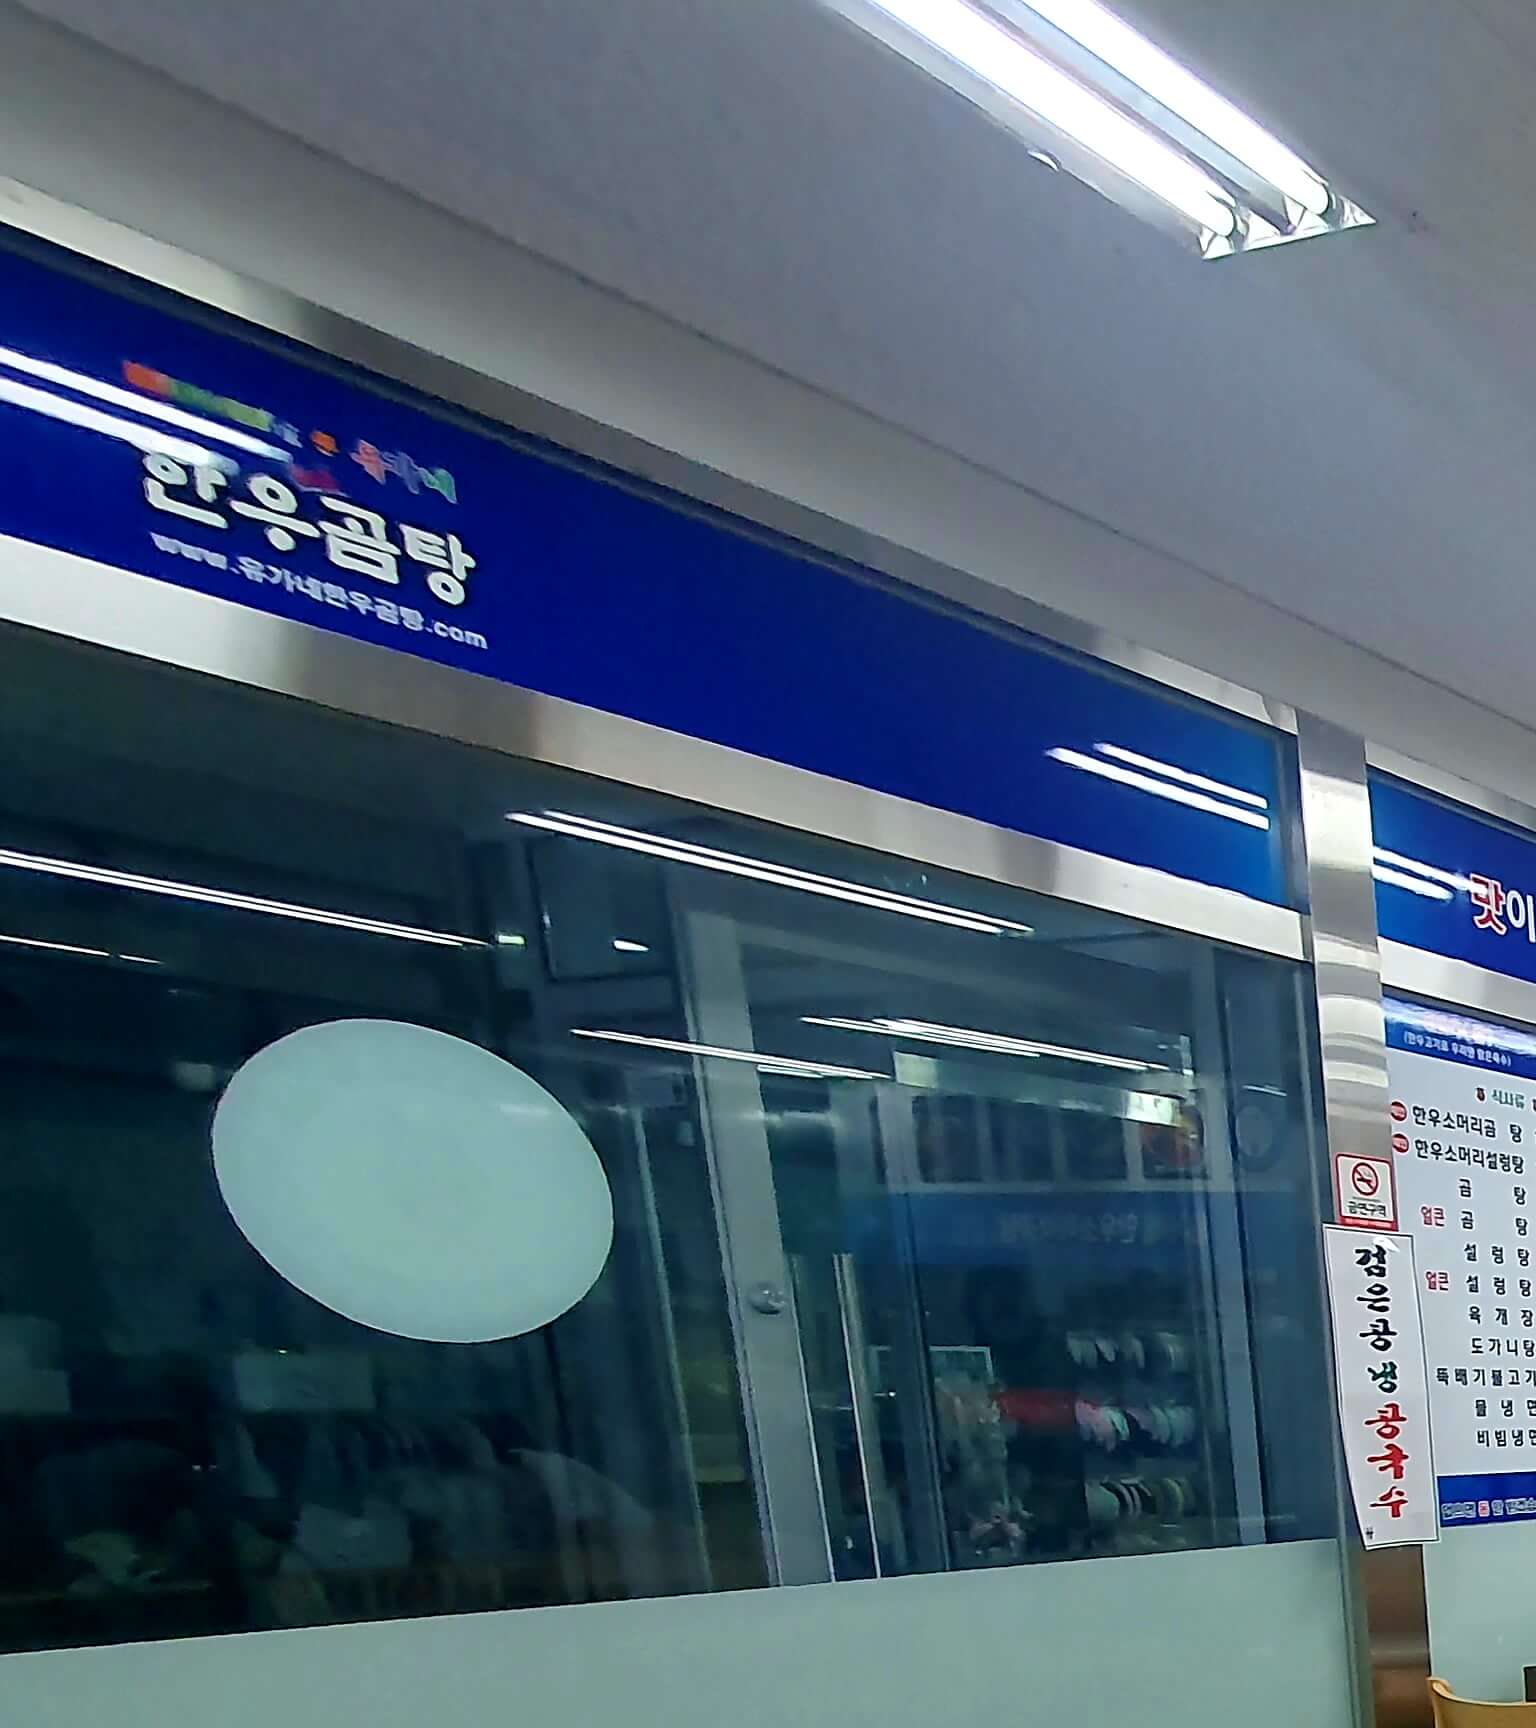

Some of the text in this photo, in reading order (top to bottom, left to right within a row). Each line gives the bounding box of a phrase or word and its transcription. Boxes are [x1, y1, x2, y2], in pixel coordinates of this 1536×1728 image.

[1414, 1138, 1525, 1175] 한우소머리설렁탕
[1420, 1205, 1446, 1227] 얼큰
[1425, 1271, 1450, 1292] 얼큰
